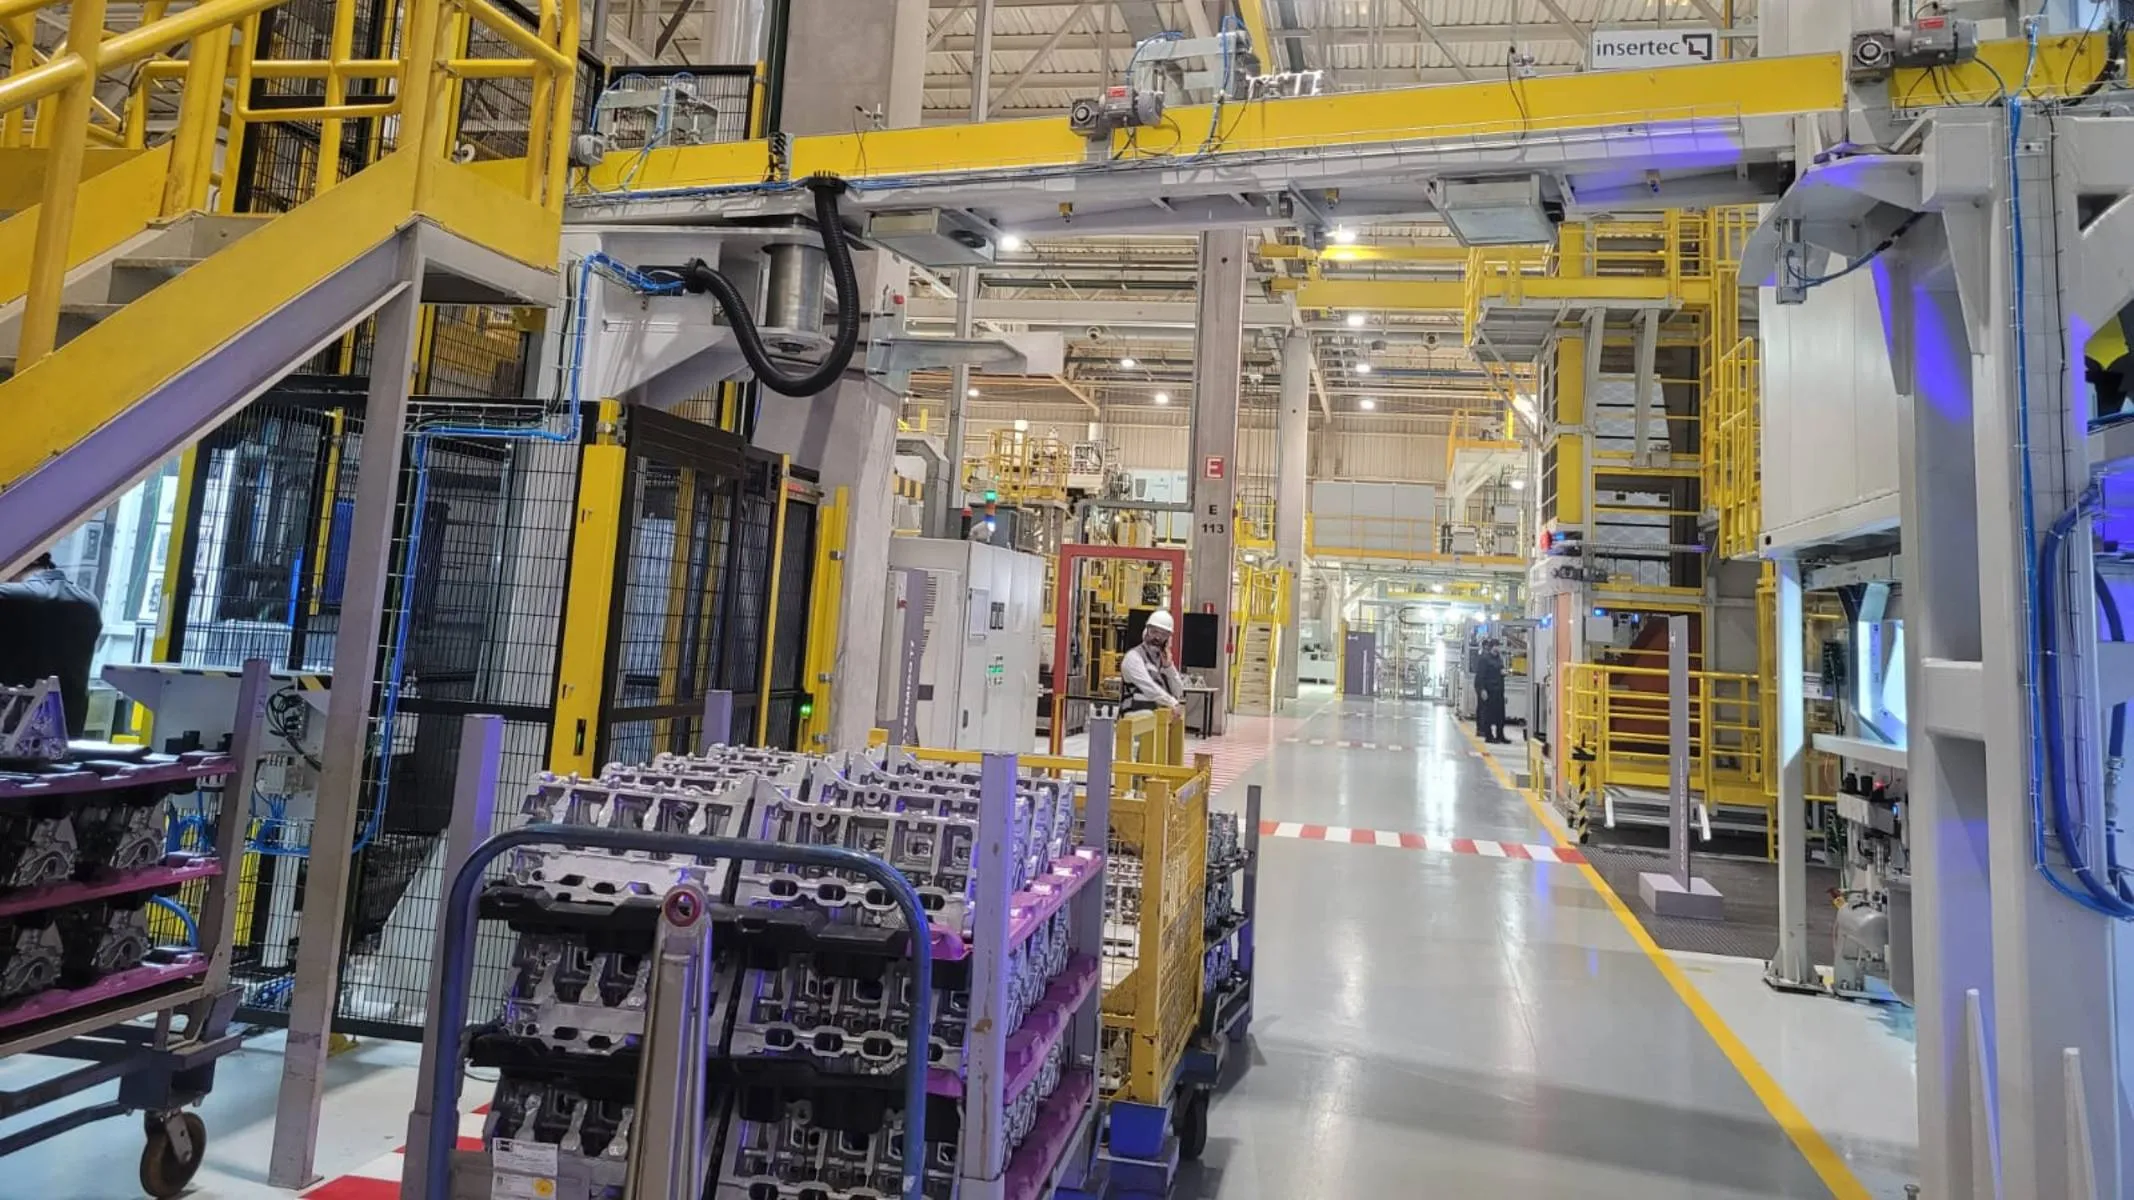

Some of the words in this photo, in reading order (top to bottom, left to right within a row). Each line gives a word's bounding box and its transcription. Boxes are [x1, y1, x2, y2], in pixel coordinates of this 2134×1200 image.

[1597, 40, 1680, 56] insertec
[1207, 458, 1221, 478] E
[1209, 505, 1218, 515] E
[1201, 523, 1224, 533] 113
